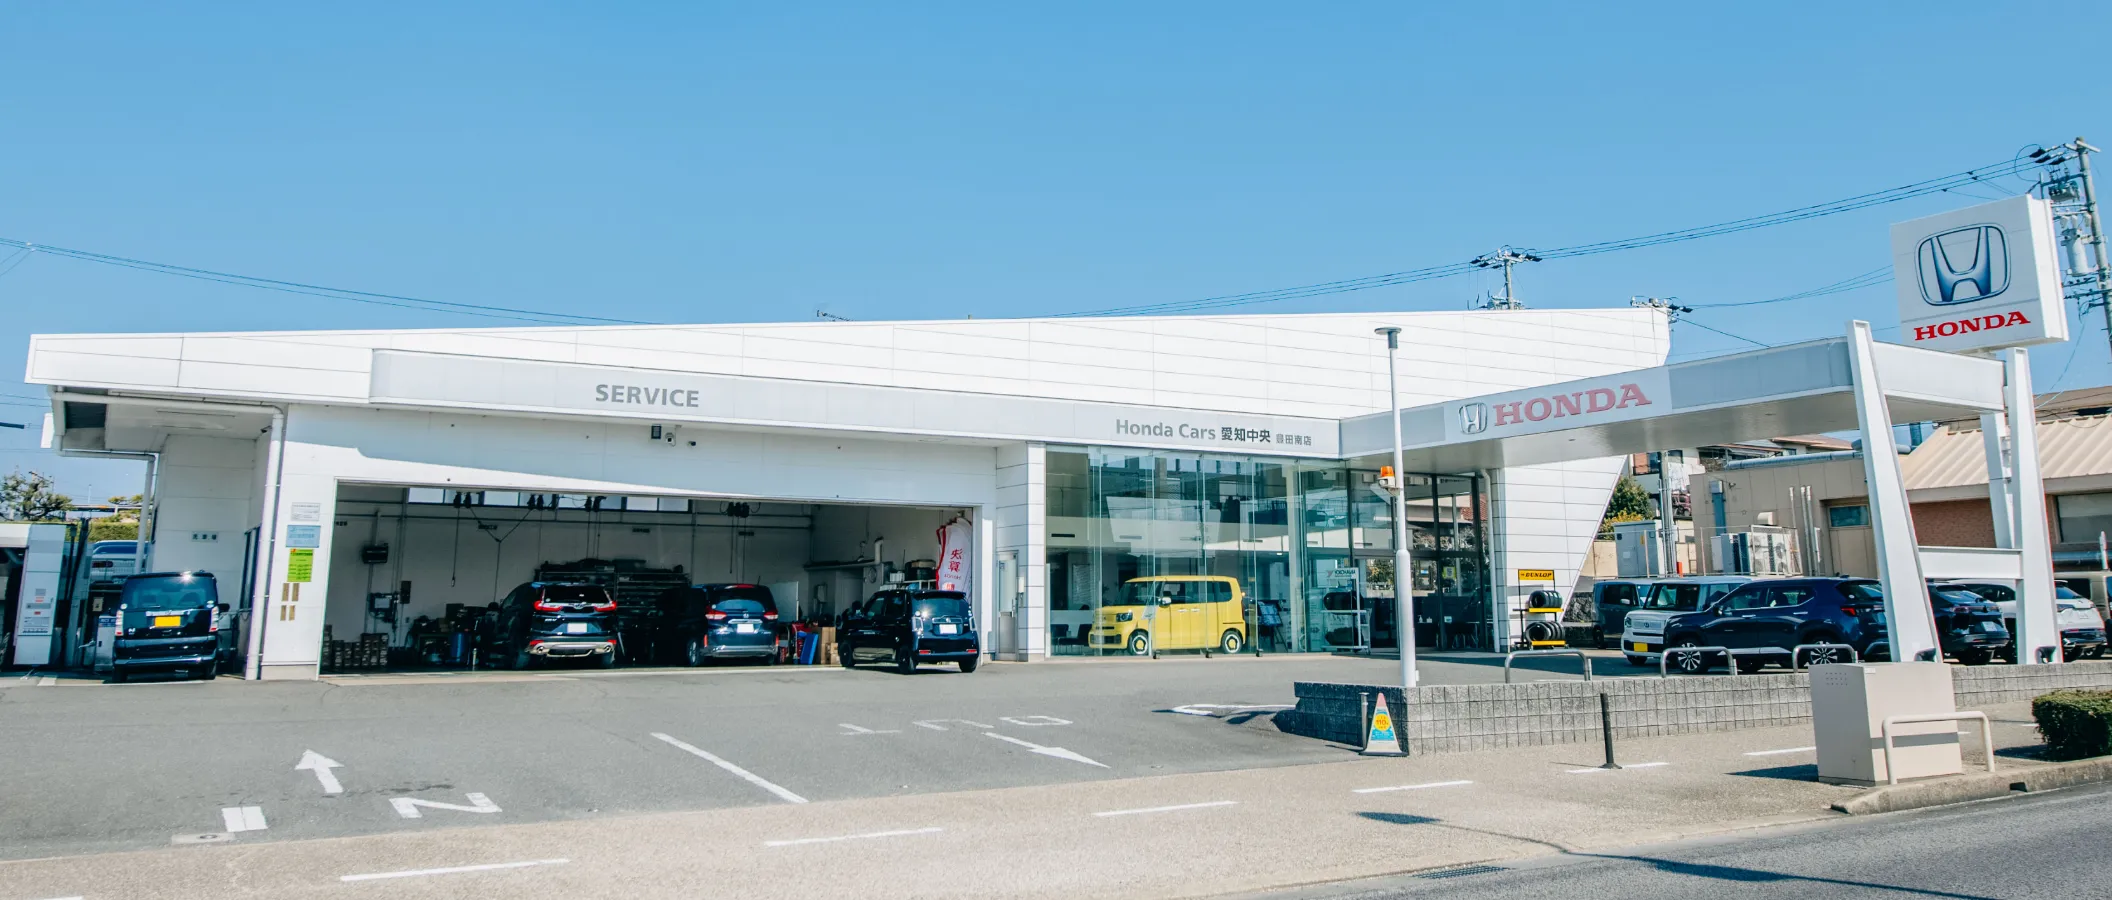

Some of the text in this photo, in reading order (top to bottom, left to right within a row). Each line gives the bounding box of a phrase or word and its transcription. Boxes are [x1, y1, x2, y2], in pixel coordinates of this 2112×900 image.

[1914, 311, 2031, 341] HONDA
[596, 384, 700, 408] SERVICE
[1493, 383, 1652, 426] HONDA
[1116, 419, 1312, 446] Honda Cars 愛知中央 豊田南店
